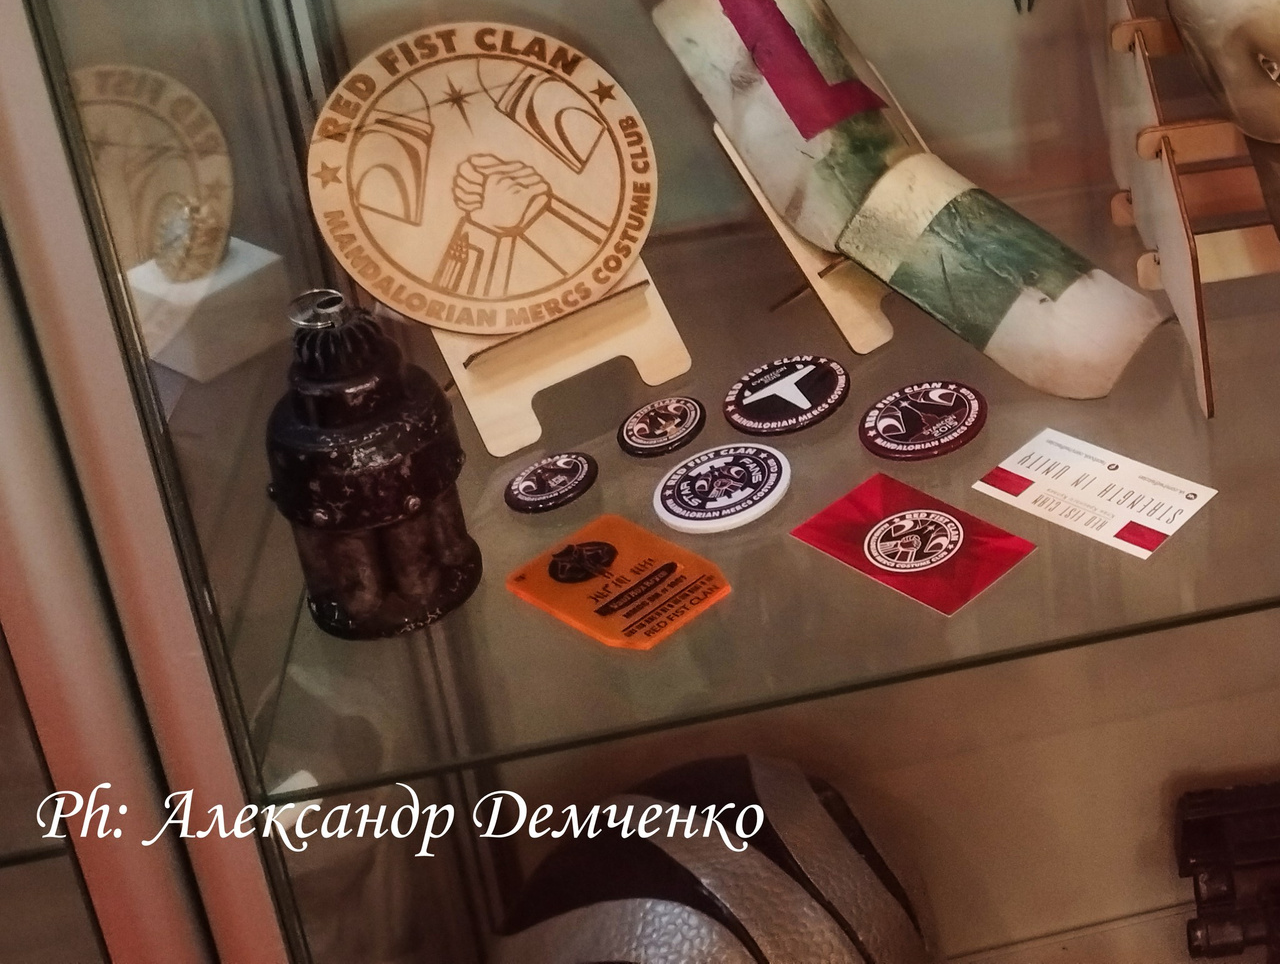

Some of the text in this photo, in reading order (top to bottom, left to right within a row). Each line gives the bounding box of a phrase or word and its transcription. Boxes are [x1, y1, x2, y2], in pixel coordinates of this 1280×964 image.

[317, 27, 588, 143] RED FIST CLAN
[323, 114, 652, 329] MANDALORIAN MERCS COSTUME CLUB
[773, 354, 814, 366] CLAN
[904, 381, 943, 394] CLAN
[666, 447, 758, 486] RED FIST CLAN
[739, 457, 764, 484] FANS
[721, 500, 753, 516] MERCS
[1016, 451, 1185, 526] STRENGTH IN UNITY
[1031, 492, 1110, 532] RED FIST CLAN
[643, 617, 667, 637] RED
[667, 603, 690, 624] FIST
[688, 585, 720, 607] CLAN
